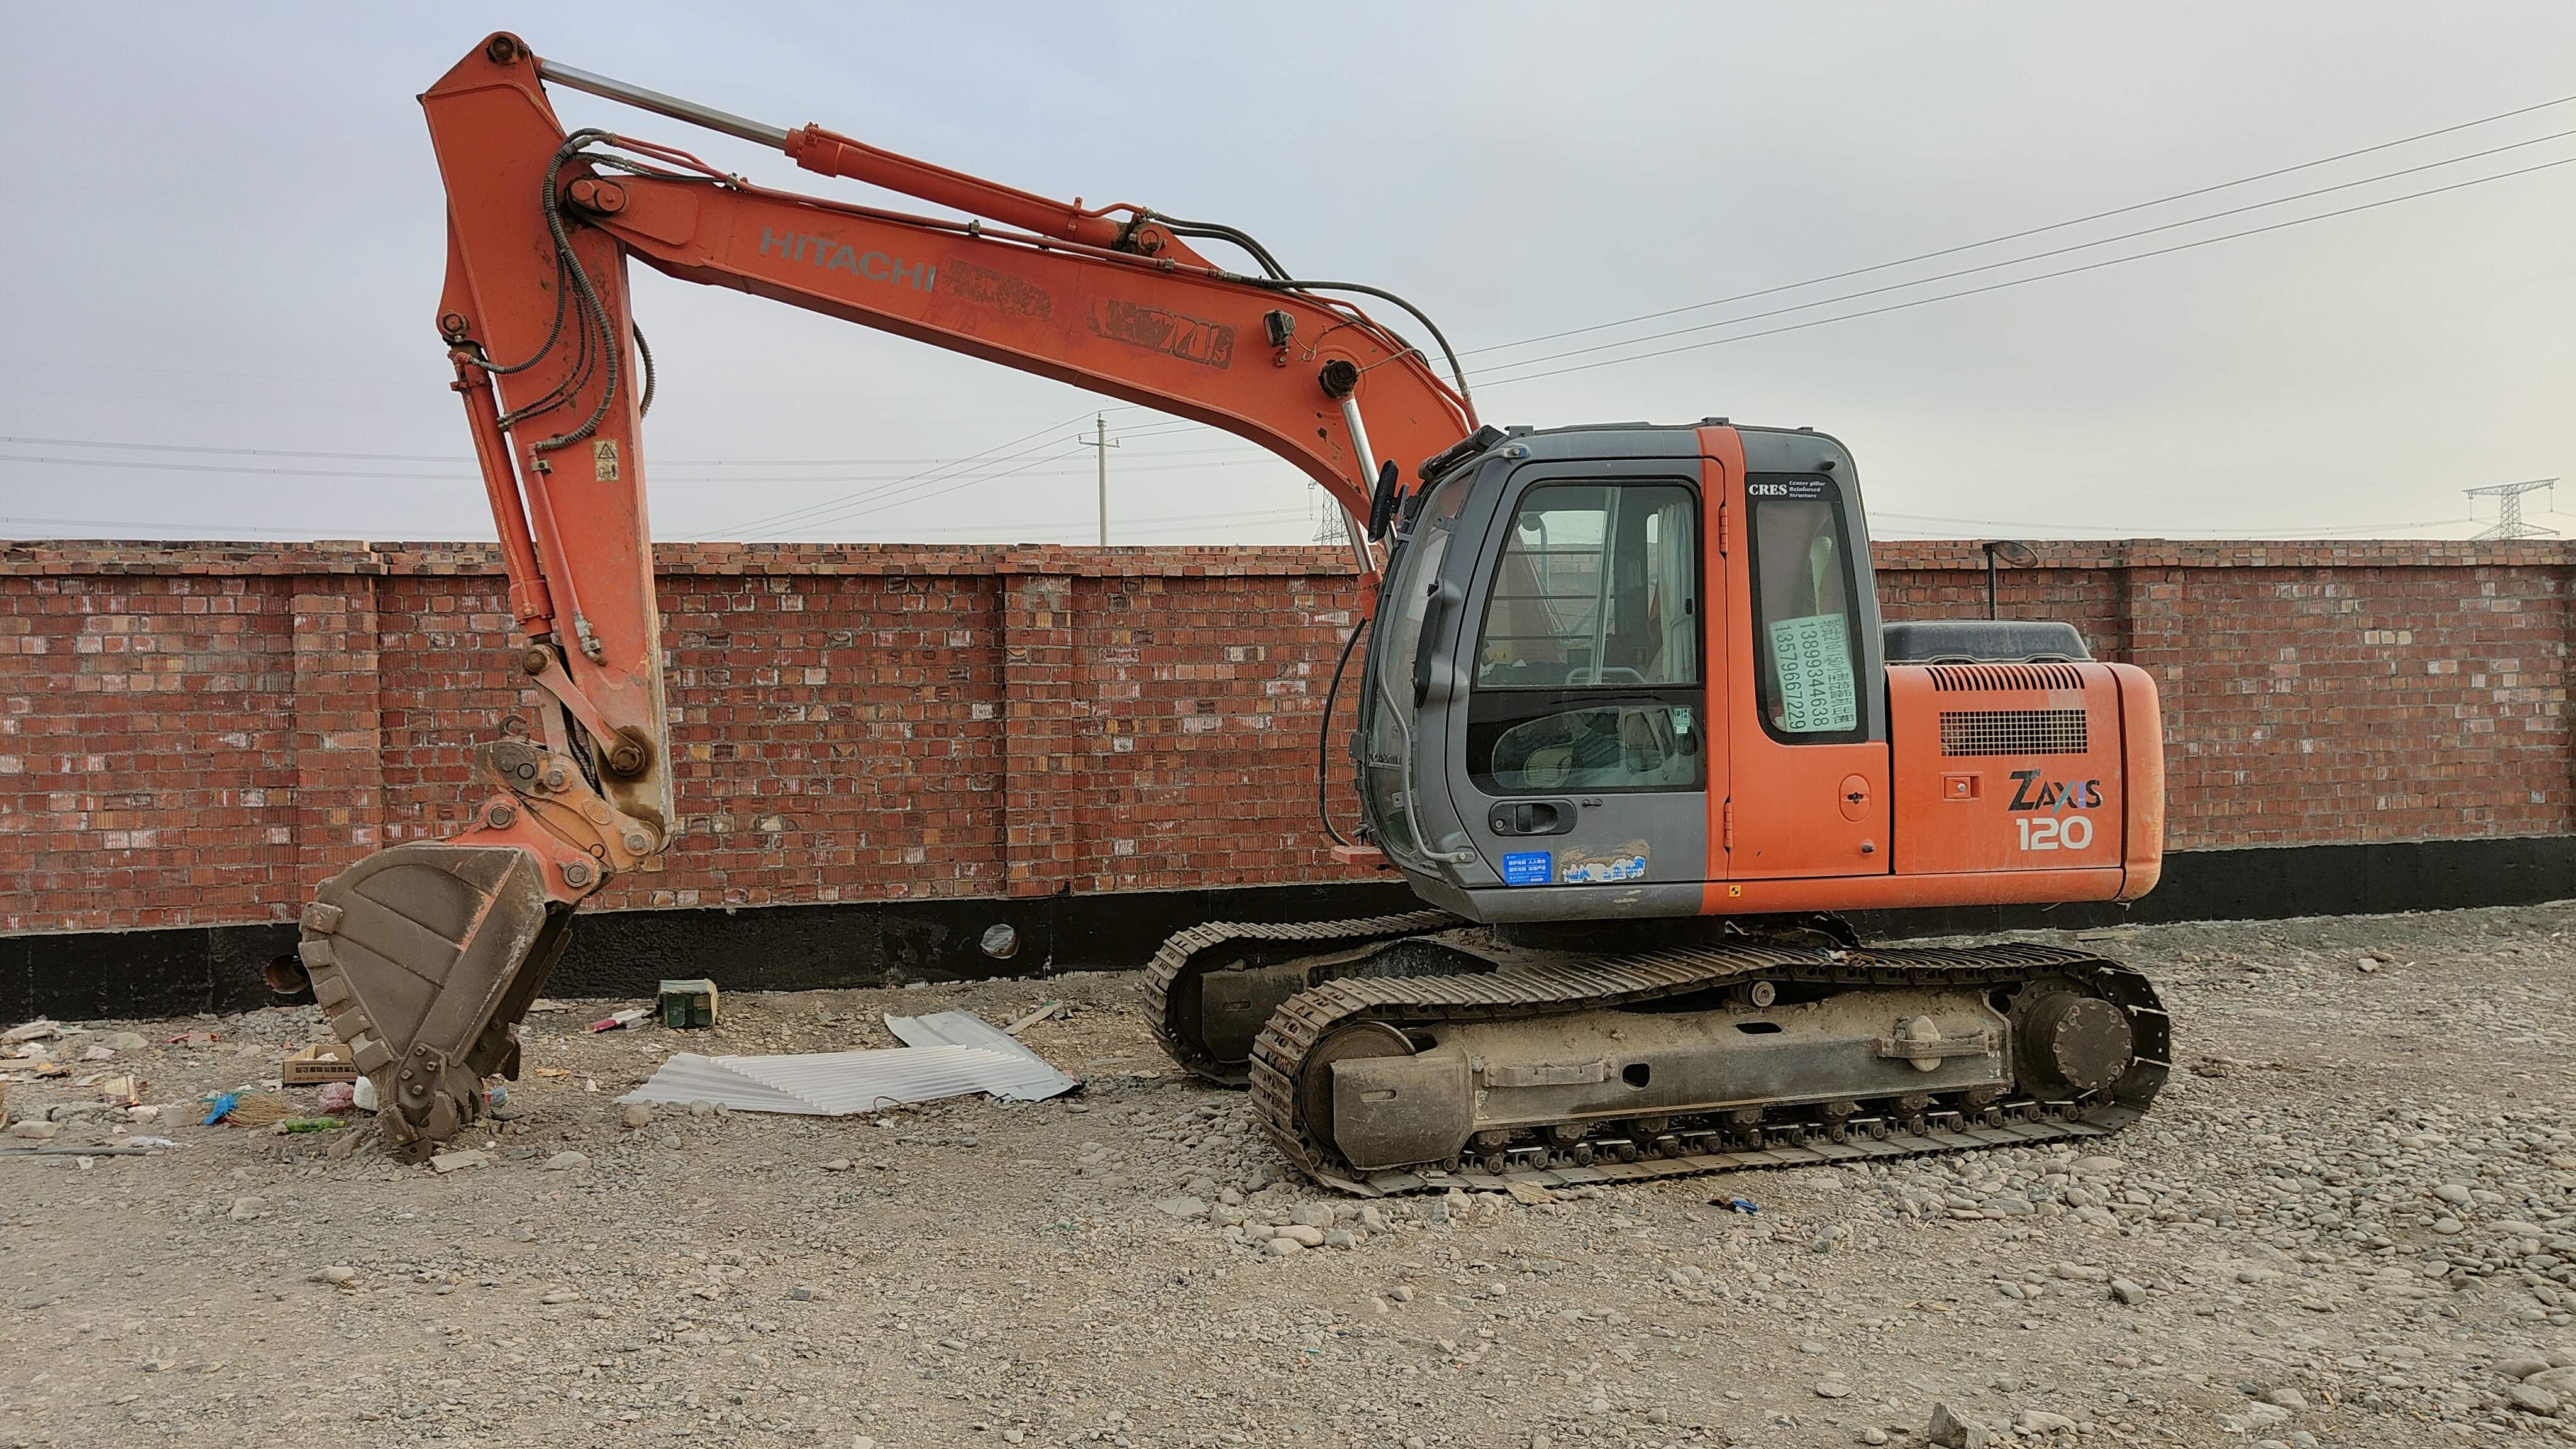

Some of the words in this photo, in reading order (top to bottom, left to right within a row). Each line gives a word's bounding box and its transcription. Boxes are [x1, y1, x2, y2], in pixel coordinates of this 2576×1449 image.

[760, 227, 935, 292] HITACHI
[1748, 484, 1787, 496] CRES
[1774, 625, 1807, 730] 13579667229
[1799, 621, 1829, 727] 13899344638
[2007, 769, 2103, 814] ZAXIS
[2016, 816, 2093, 850] 120
